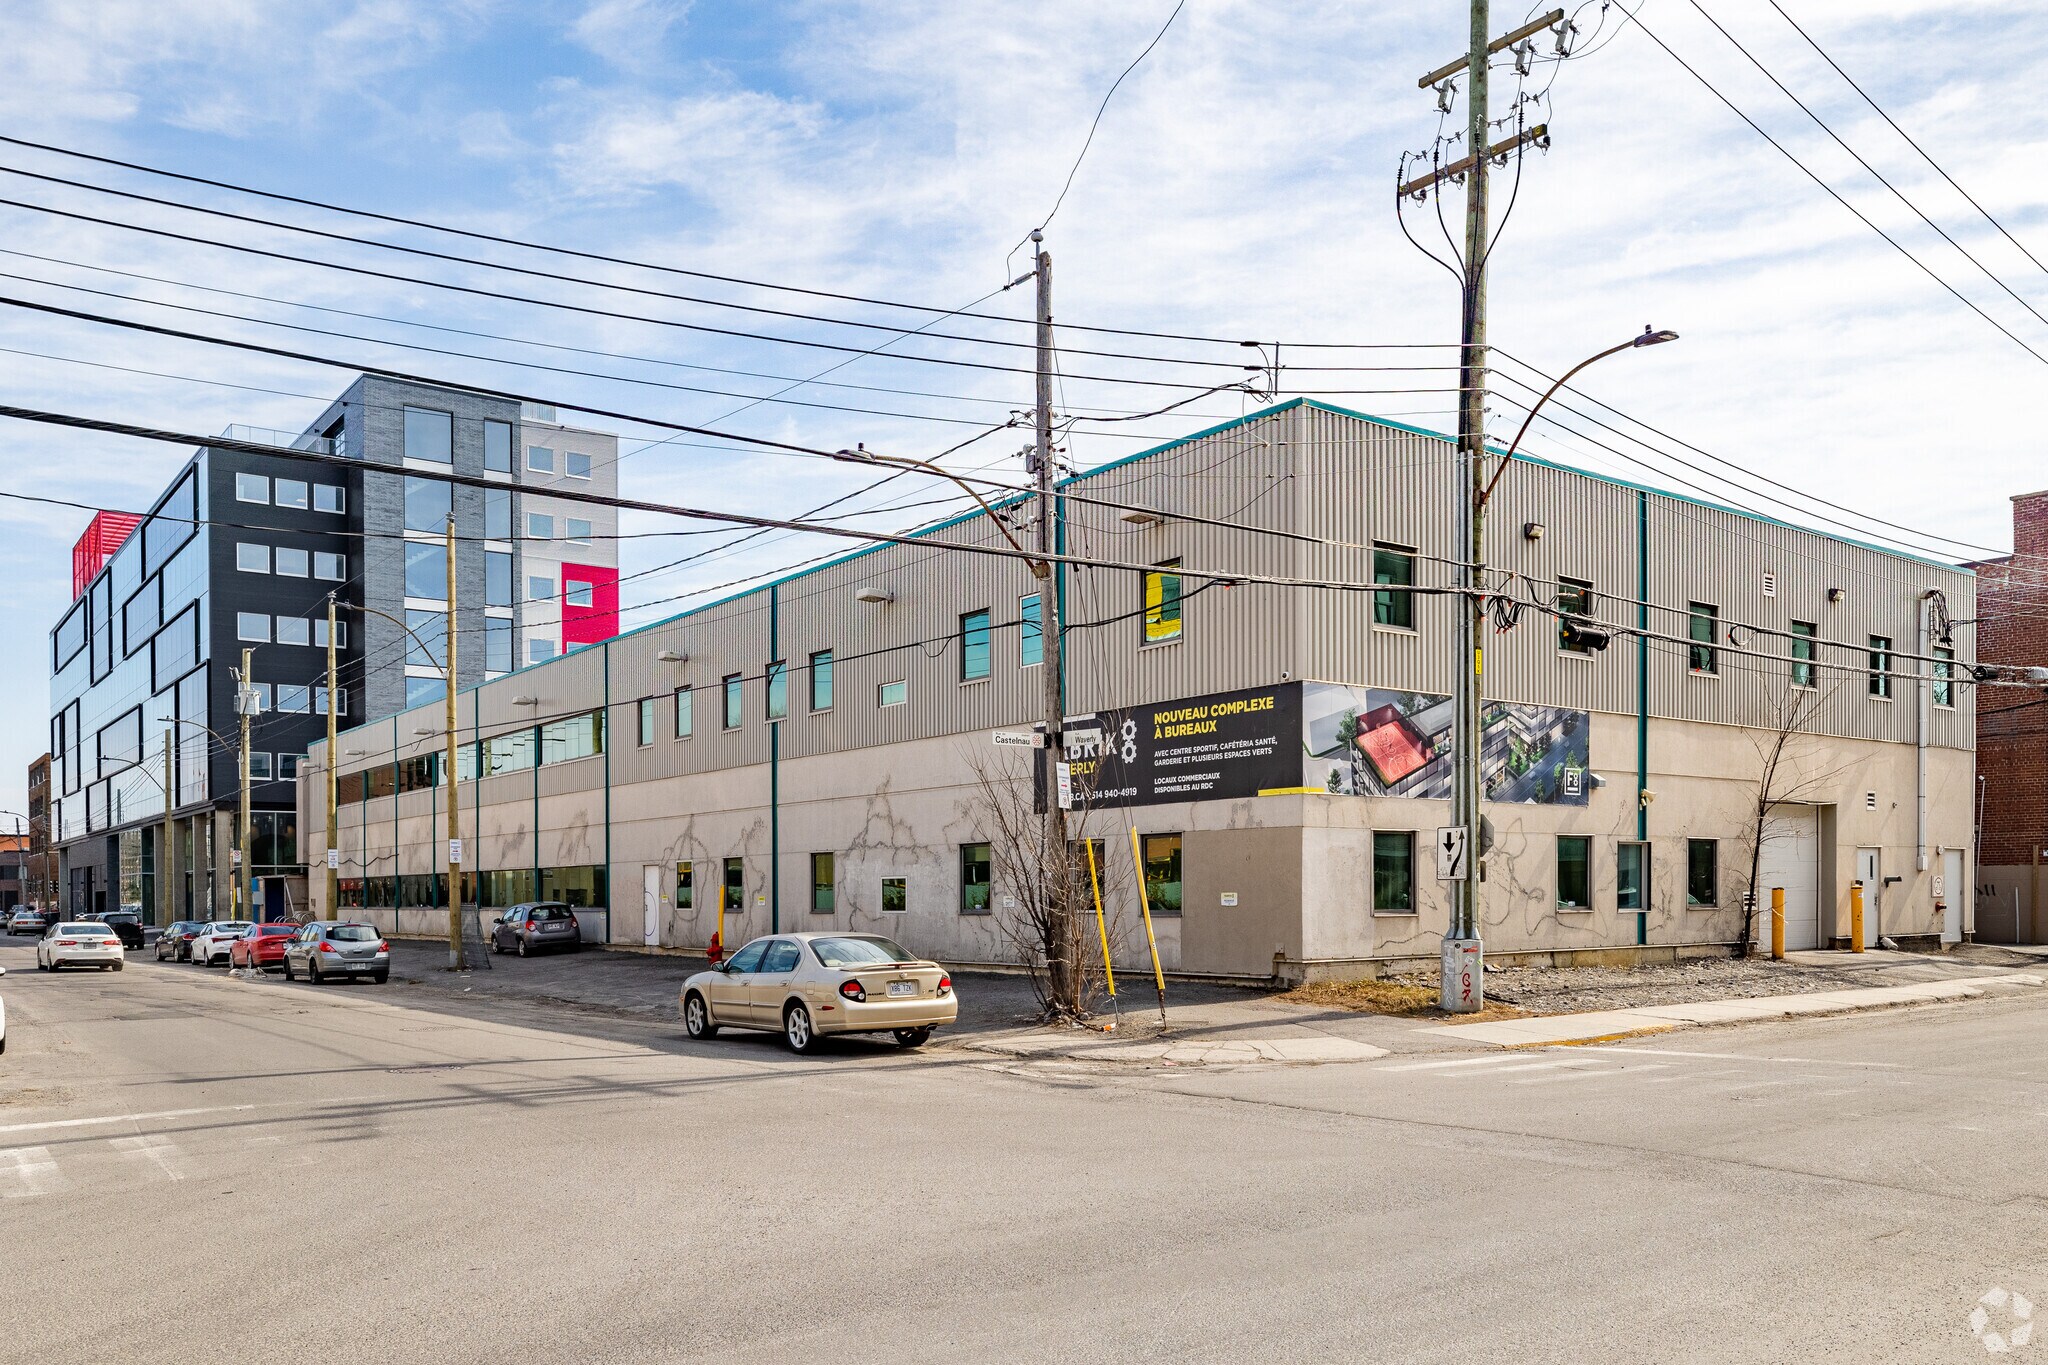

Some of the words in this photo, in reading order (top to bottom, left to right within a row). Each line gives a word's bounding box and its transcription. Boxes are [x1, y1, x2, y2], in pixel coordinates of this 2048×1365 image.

[1154, 706, 1208, 724] NOUVEAU
[1210, 697, 1274, 717] COMPLEXE
[1154, 725, 1162, 739] À
[1165, 720, 1217, 738] BUREAUX
[995, 736, 1030, 745] Castelnau
[1075, 735, 1097, 744] Waverly
[1154, 748, 1169, 757] AVEC
[1170, 745, 1192, 755] CENTRE
[1193, 744, 1219, 753] SPORTIF,
[1220, 739, 1253, 750] CAFÉTÉRIA
[1255, 736, 1278, 746] SANTÉ,
[1154, 757, 1182, 766] GARDERIE
[1192, 753, 1223, 762] PLUSIEURS
[1224, 749, 1251, 759] ESPACES
[1252, 747, 1272, 756] VERTS
[1070, 761, 1096, 775] ERLY
[1154, 776, 1177, 784] LOCAUX
[1178, 772, 1220, 783] COMMERCIAUX
[1104, 787, 1137, 798] 940-4919
[1154, 785, 1190, 793] DISPONIBLES
[1201, 782, 1213, 790] RDC
